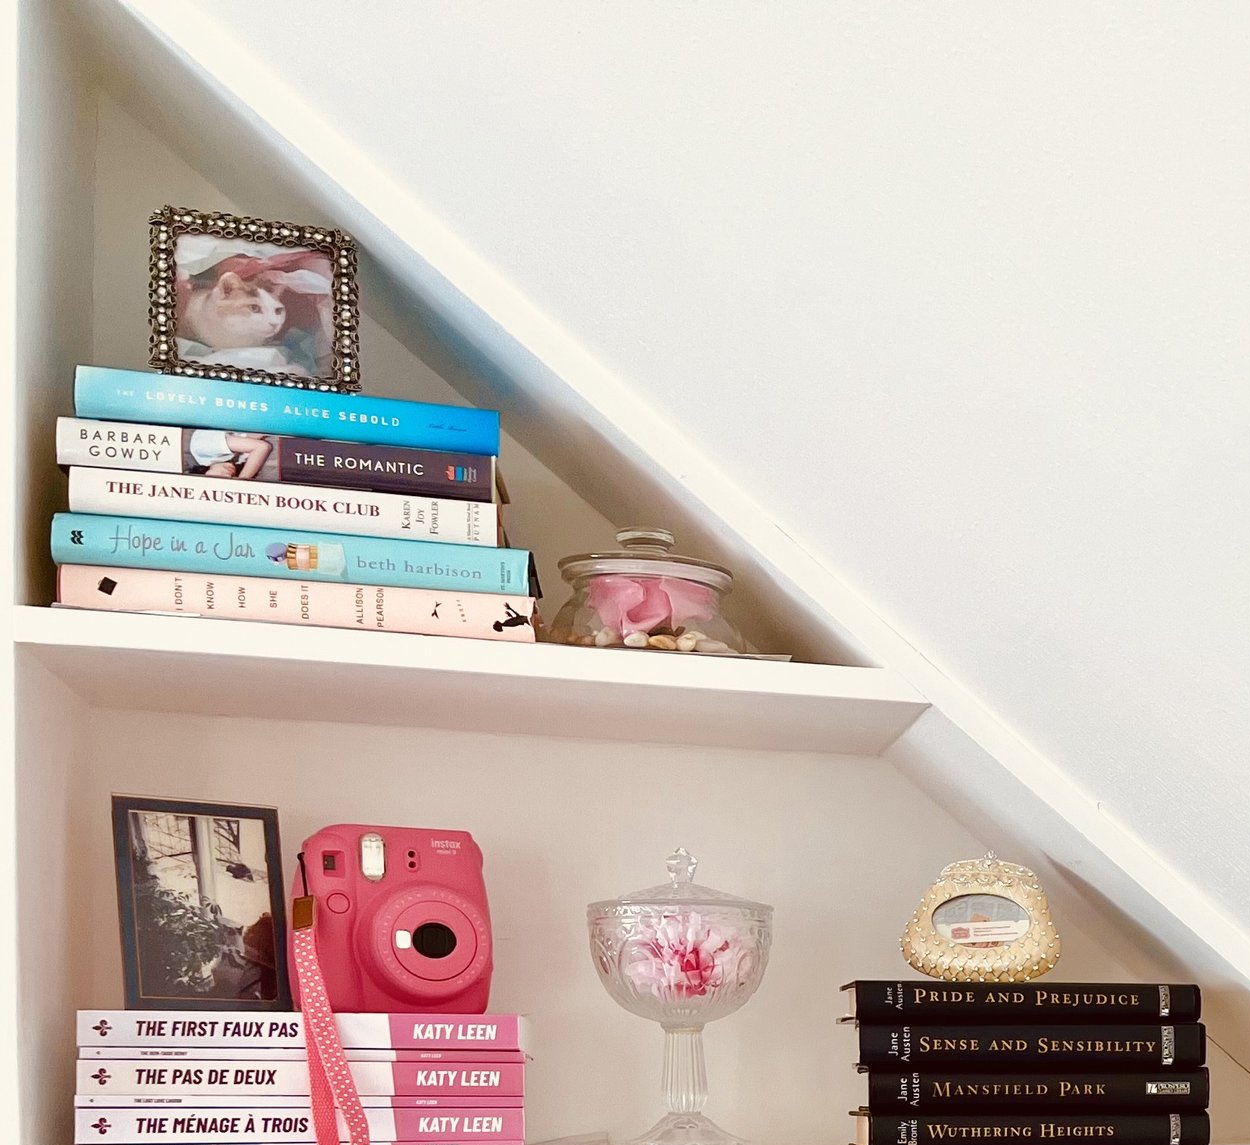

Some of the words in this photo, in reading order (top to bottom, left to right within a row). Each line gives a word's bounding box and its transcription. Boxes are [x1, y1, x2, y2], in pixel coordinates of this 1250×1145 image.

[146, 391, 207, 405] LOVELY
[216, 398, 269, 411] BONES
[283, 405, 330, 418] ALICE
[339, 411, 399, 426] SEBOLD
[80, 429, 170, 445] BARBARA
[89, 445, 161, 461] GOWDY
[295, 453, 325, 466] THE
[334, 457, 424, 475] ROMANTIC
[107, 481, 143, 495] THE
[148, 485, 194, 499] JANE
[200, 490, 270, 506] AUSTEN
[276, 496, 327, 512] BOOK
[333, 501, 380, 517] CLUB
[357, 556, 396, 571] beth
[404, 561, 482, 579] harbison
[431, 839, 461, 849] instax
[914, 989, 975, 1003] PRIDE
[985, 992, 1024, 1002] AND
[1036, 991, 1139, 1006] PREJUDICE
[136, 1021, 167, 1037] THE
[172, 1021, 218, 1037] FIRST
[223, 1022, 264, 1037] FAUX
[269, 1023, 298, 1037] PAS
[414, 1024, 454, 1040] KATY
[457, 1025, 497, 1040] LEEN
[889, 1032, 898, 1056] Jane
[901, 1027, 910, 1062] Austen
[920, 1037, 979, 1052] SENSE
[989, 1040, 1028, 1050] AND
[1038, 1038, 1156, 1053] SENSIBILITY
[136, 1069, 168, 1084] THE
[172, 1070, 203, 1084] PAS
[208, 1070, 229, 1084] DE
[234, 1070, 277, 1085] DEUX
[933, 1082, 1048, 1097] MANSFIELD
[1060, 1082, 1106, 1096] PARK
[136, 1118, 168, 1133] THE
[173, 1114, 241, 1133] MÉNAGE
[245, 1114, 255, 1132] À
[262, 1118, 308, 1132] TROIS
